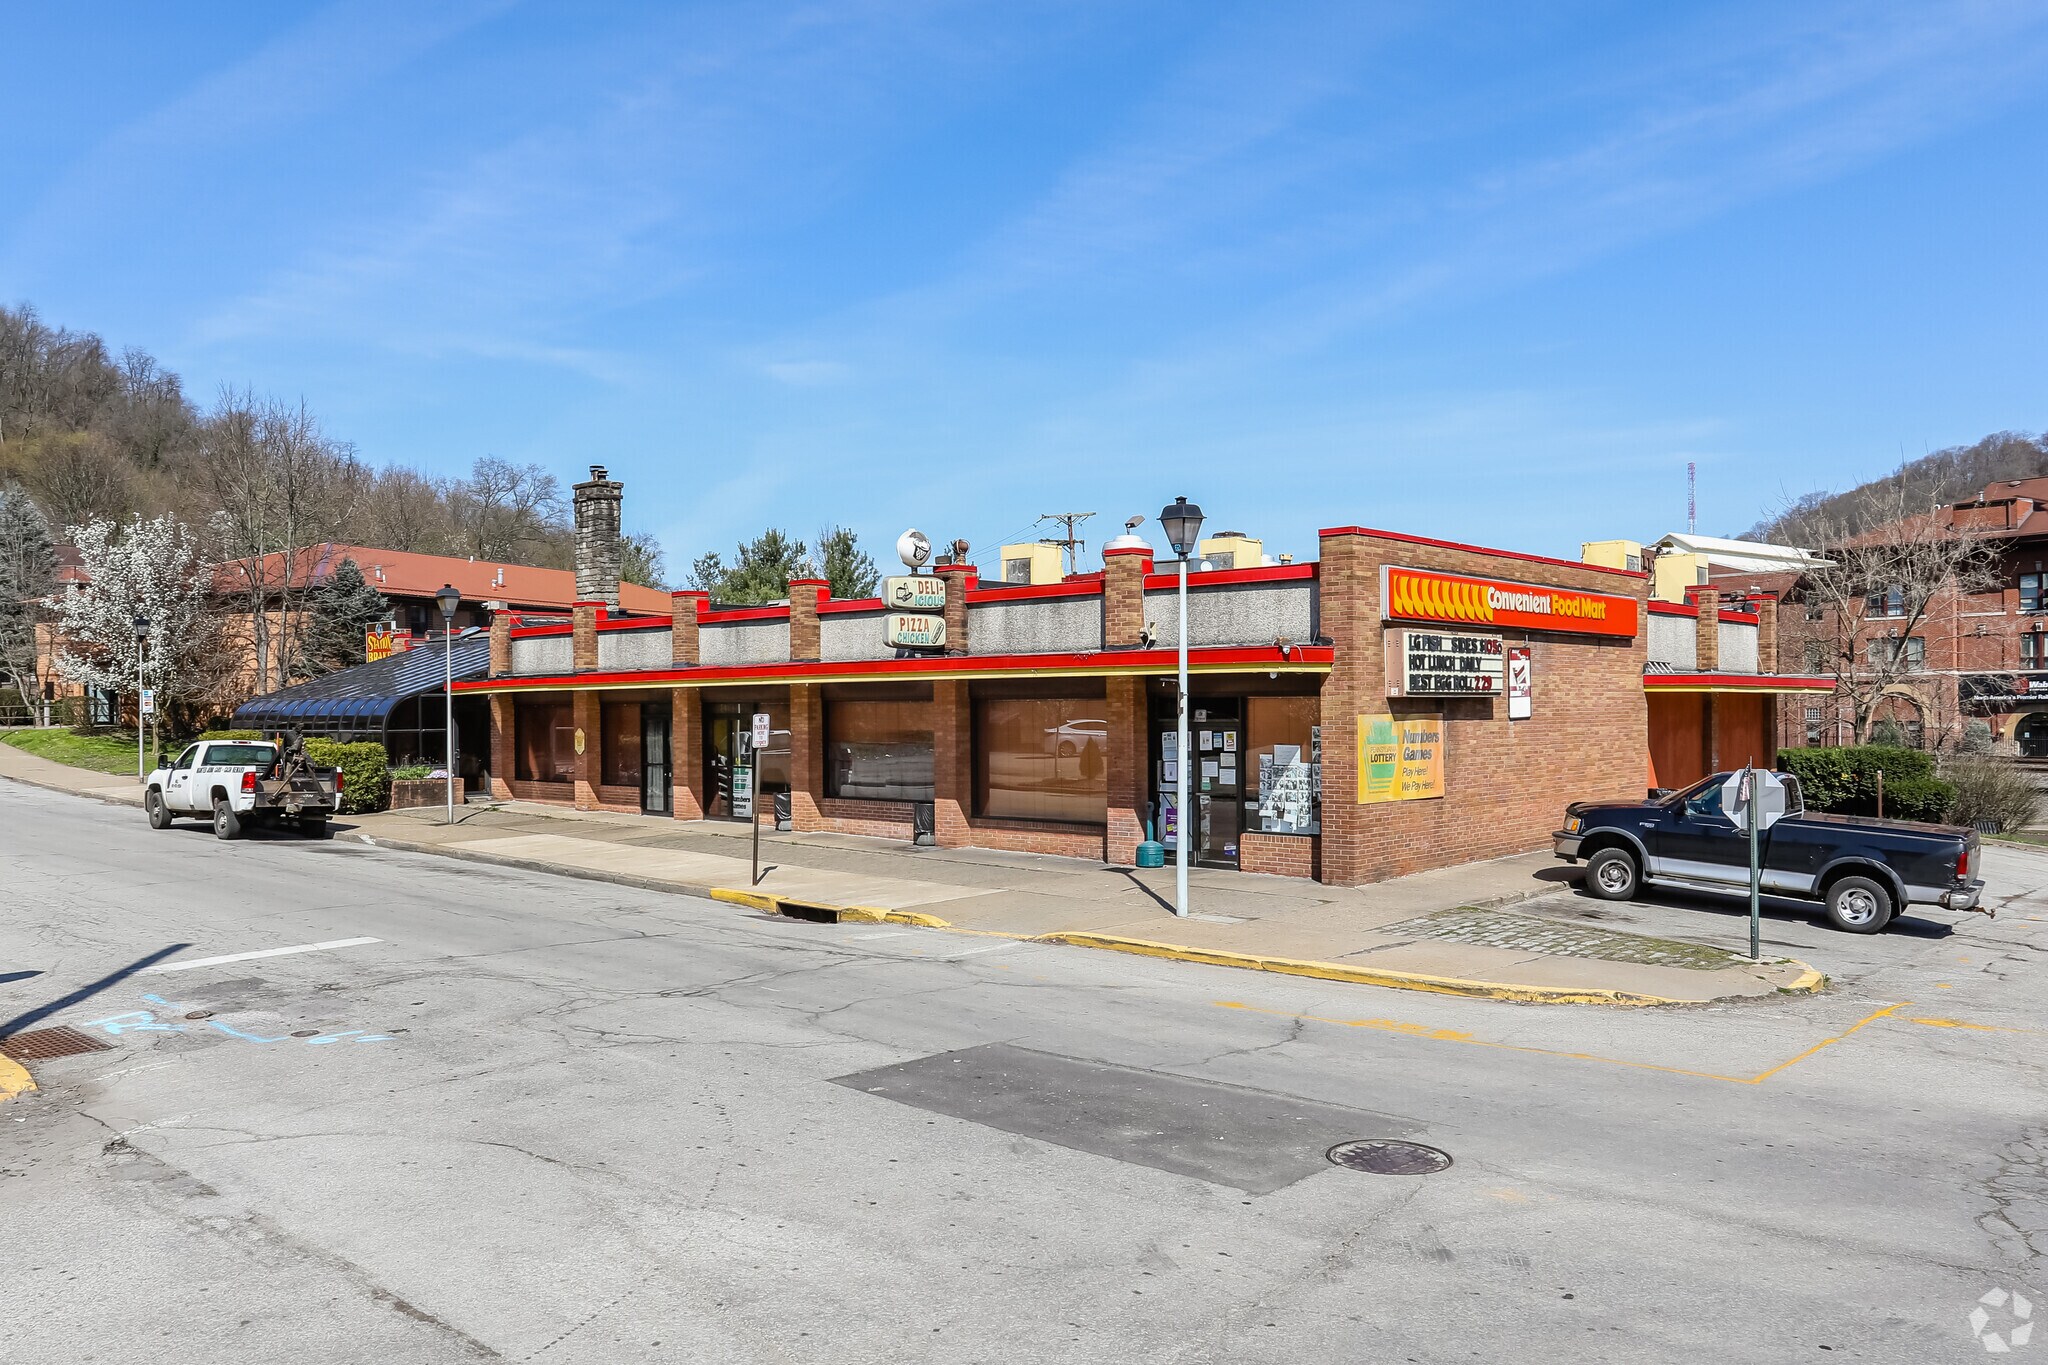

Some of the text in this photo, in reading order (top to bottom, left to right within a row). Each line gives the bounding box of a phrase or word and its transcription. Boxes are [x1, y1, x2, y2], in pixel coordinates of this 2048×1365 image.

[1488, 586, 1606, 620] Convenient Food Mart
[900, 617, 929, 632] PIZZA
[897, 632, 930, 644] CHICKEN
[1422, 635, 1442, 651] FISH
[1451, 637, 1478, 654] SIDES
[1408, 654, 1482, 673] HOT LUNCH DAILY
[1409, 674, 1432, 691] BEST
[1434, 674, 1452, 691] EGG
[1454, 675, 1475, 691] ROLL
[1402, 729, 1439, 744] Numbers
[1370, 753, 1397, 762] LOTTERY
[1403, 746, 1432, 761] Games
[1402, 766, 1428, 778] Play Here!
[1402, 780, 1435, 792] We Pay Here!
